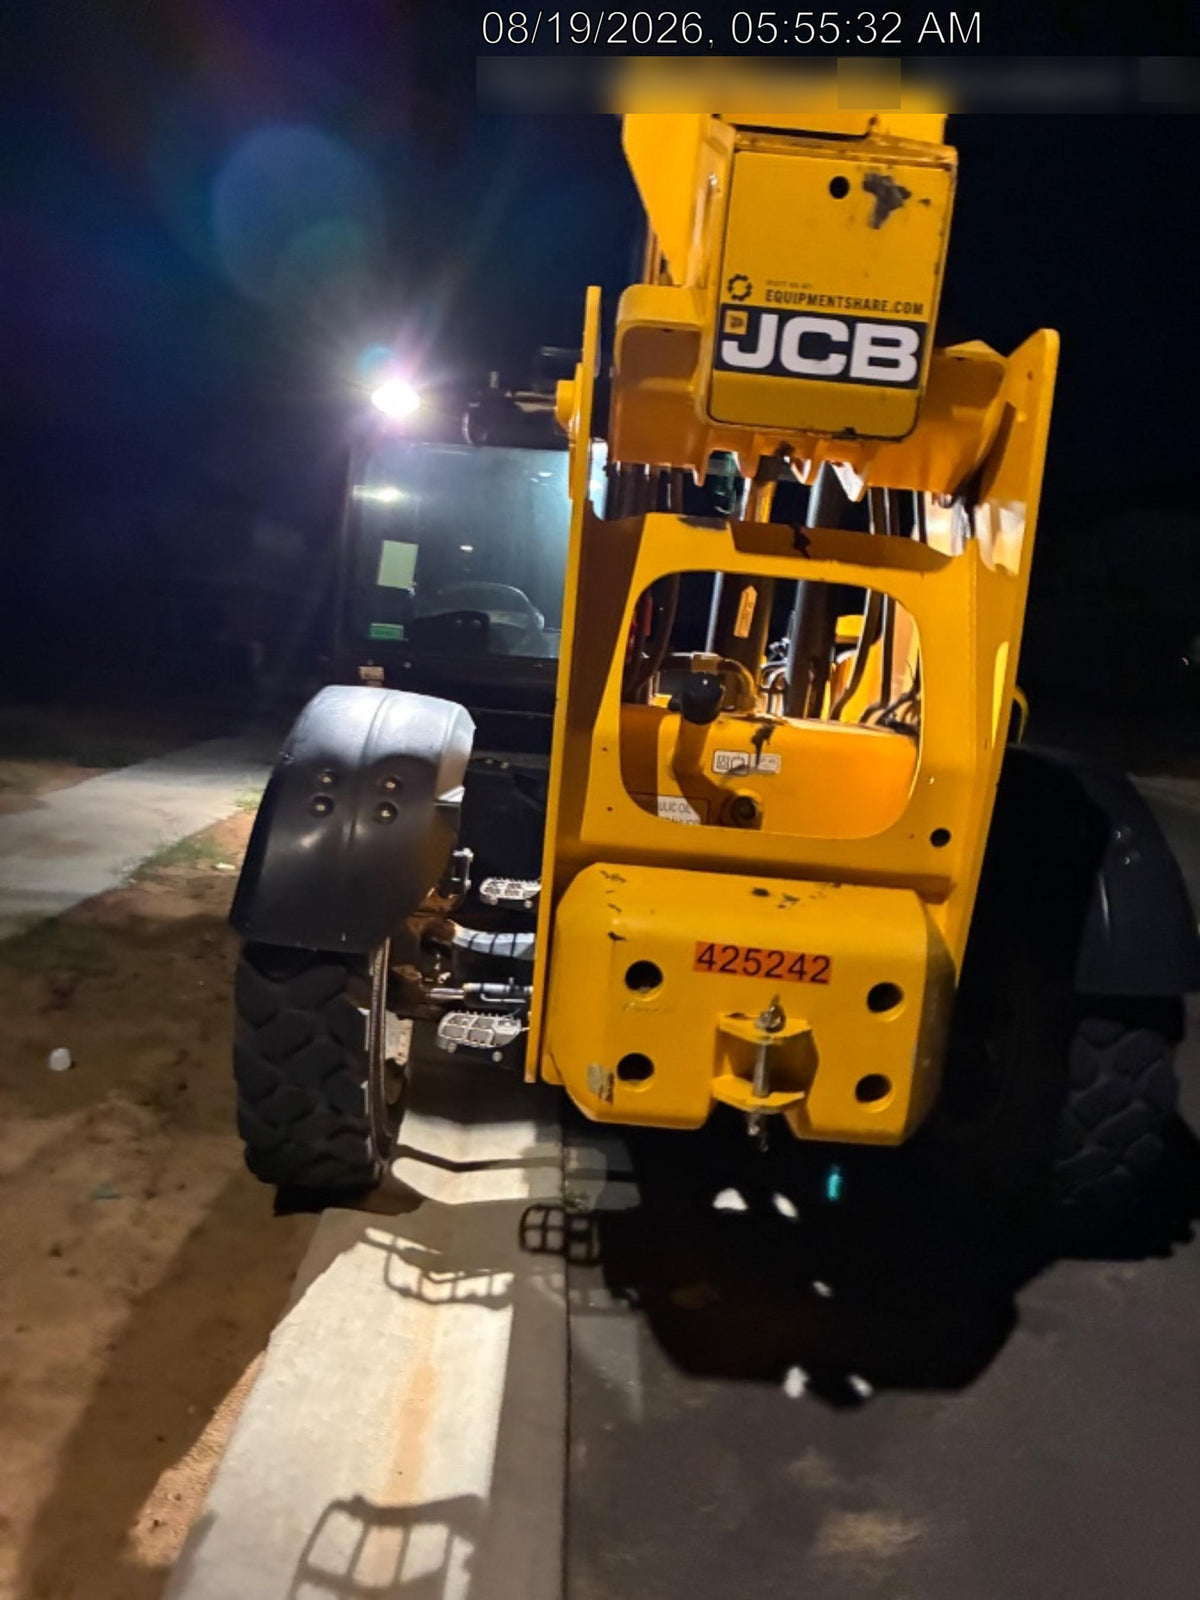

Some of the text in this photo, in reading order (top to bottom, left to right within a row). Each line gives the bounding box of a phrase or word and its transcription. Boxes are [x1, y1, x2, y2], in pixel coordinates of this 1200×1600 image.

[766, 289, 924, 315] EQUIPMENTSHARE.COM
[721, 313, 920, 382] JCB
[697, 943, 831, 984] 425242
